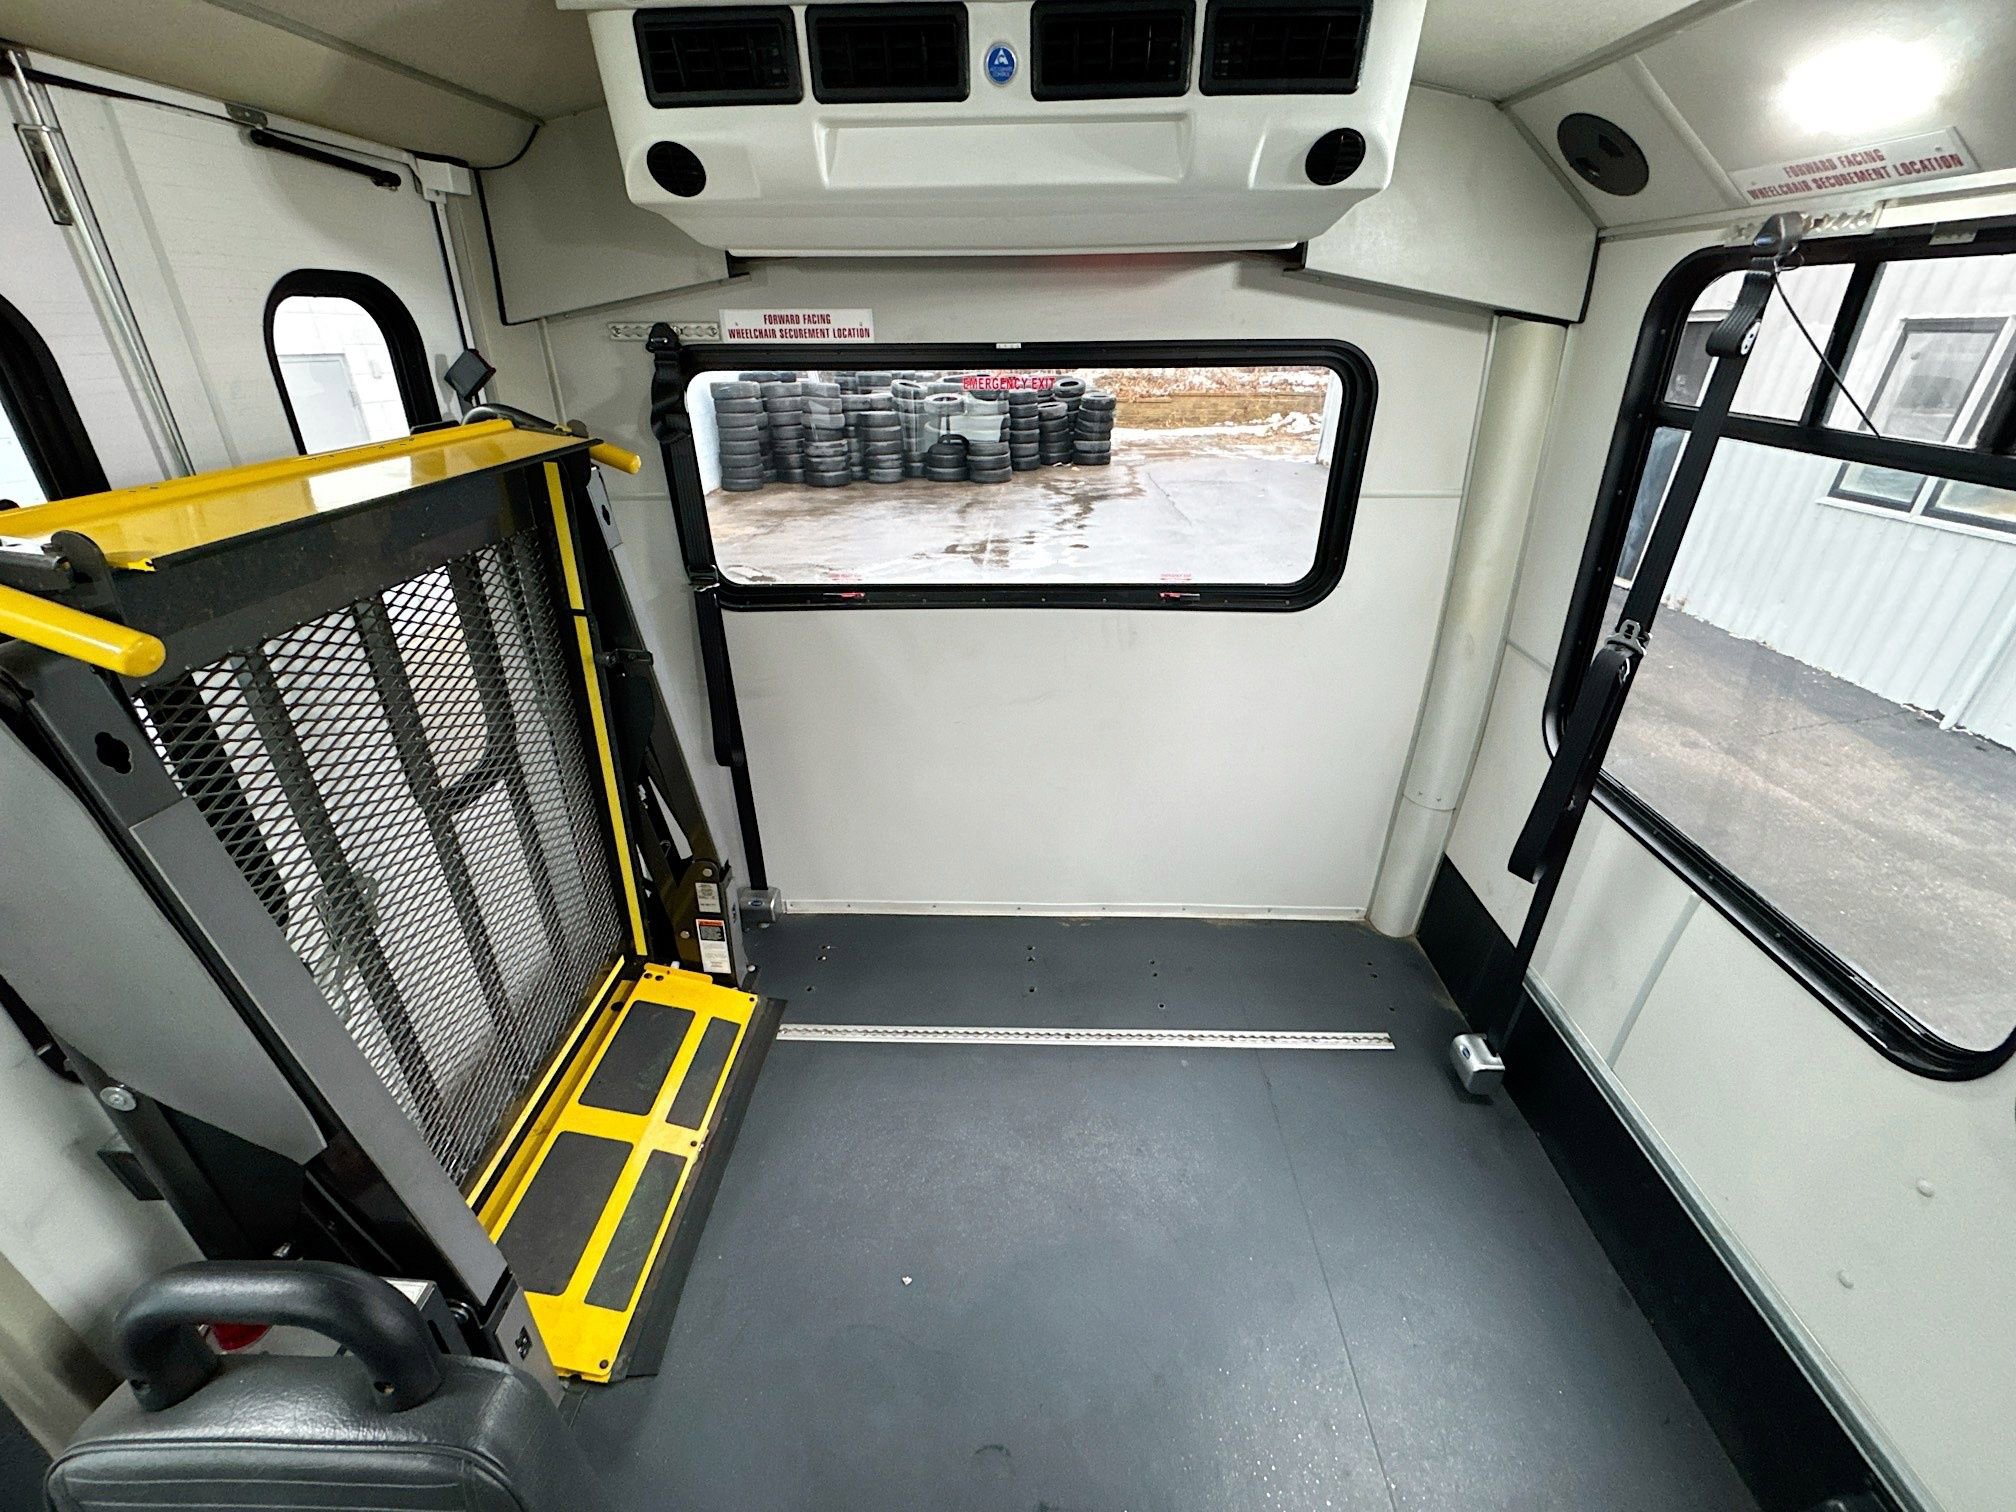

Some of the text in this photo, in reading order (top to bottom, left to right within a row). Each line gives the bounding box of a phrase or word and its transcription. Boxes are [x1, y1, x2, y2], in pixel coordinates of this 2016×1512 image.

[1783, 149, 1886, 179] FORWARD FACING
[1747, 153, 1964, 201] WHEELCHAIR SECUREMENT LOCATION
[763, 313, 832, 325] FORWARD FACING
[728, 327, 870, 340] WHEELCHAIR SECUREMENT LOCATION
[963, 377, 1056, 390] EMERGENCY EXIT
